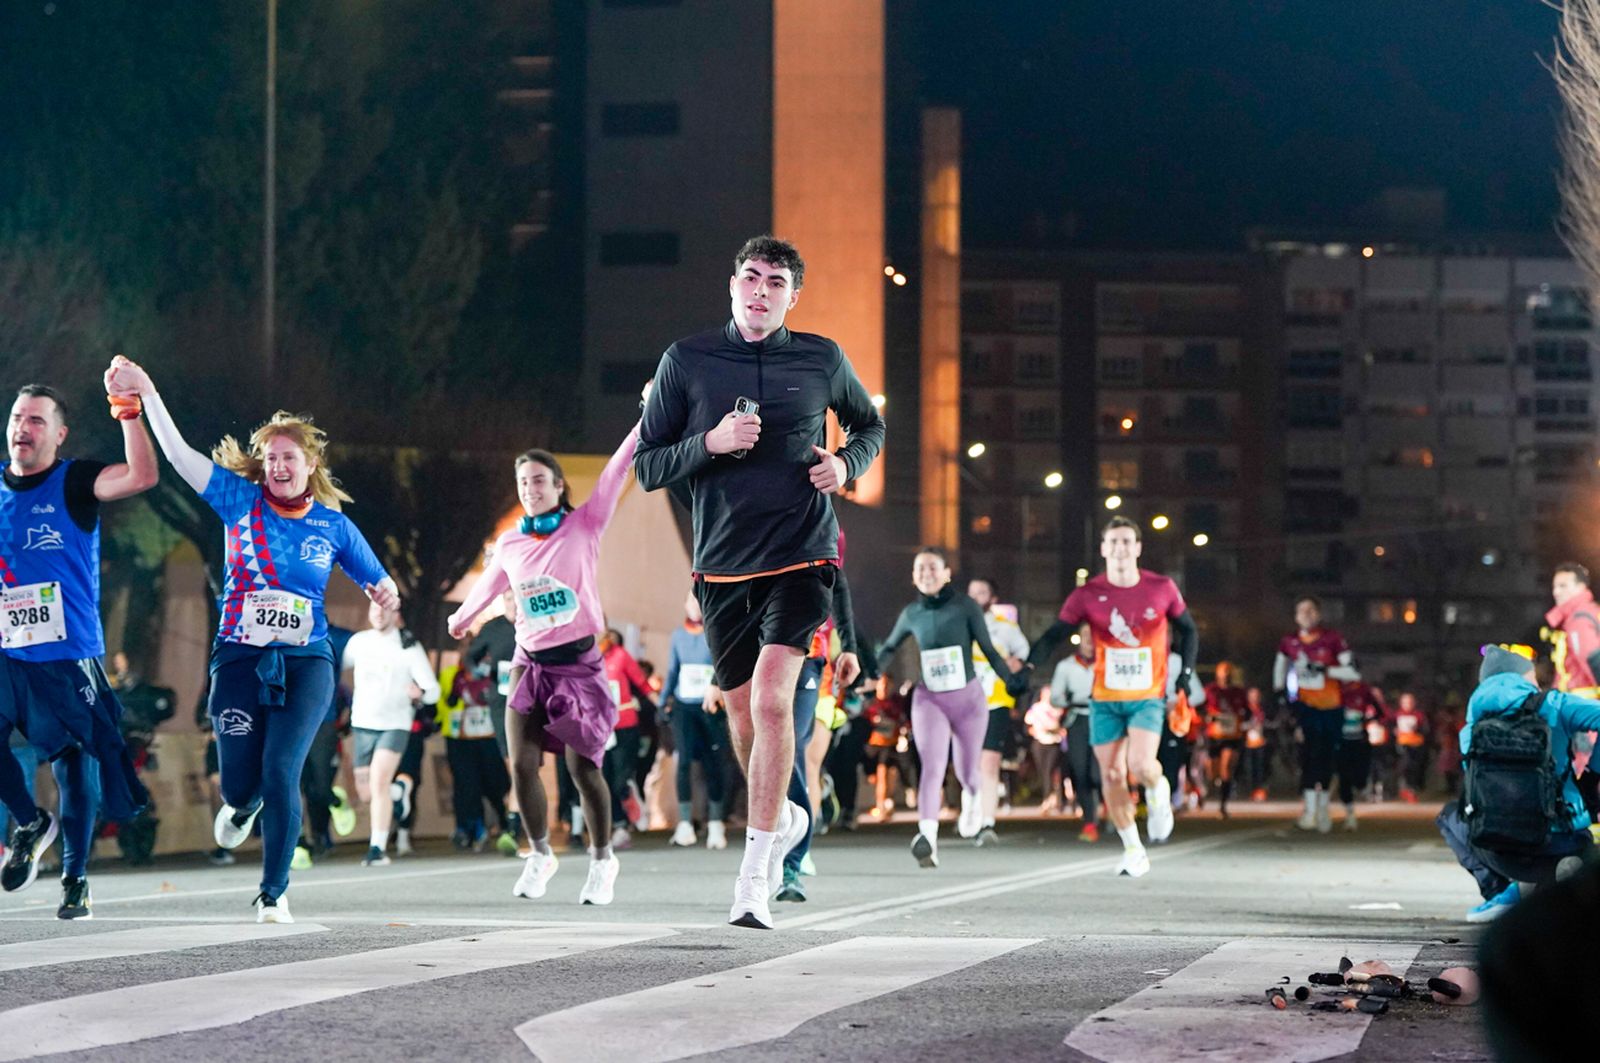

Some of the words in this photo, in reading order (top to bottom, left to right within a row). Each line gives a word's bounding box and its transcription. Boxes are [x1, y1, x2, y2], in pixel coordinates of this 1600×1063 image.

[529, 590, 567, 612] 8543
[8, 605, 50, 627] 3288
[256, 608, 301, 629] 3289
